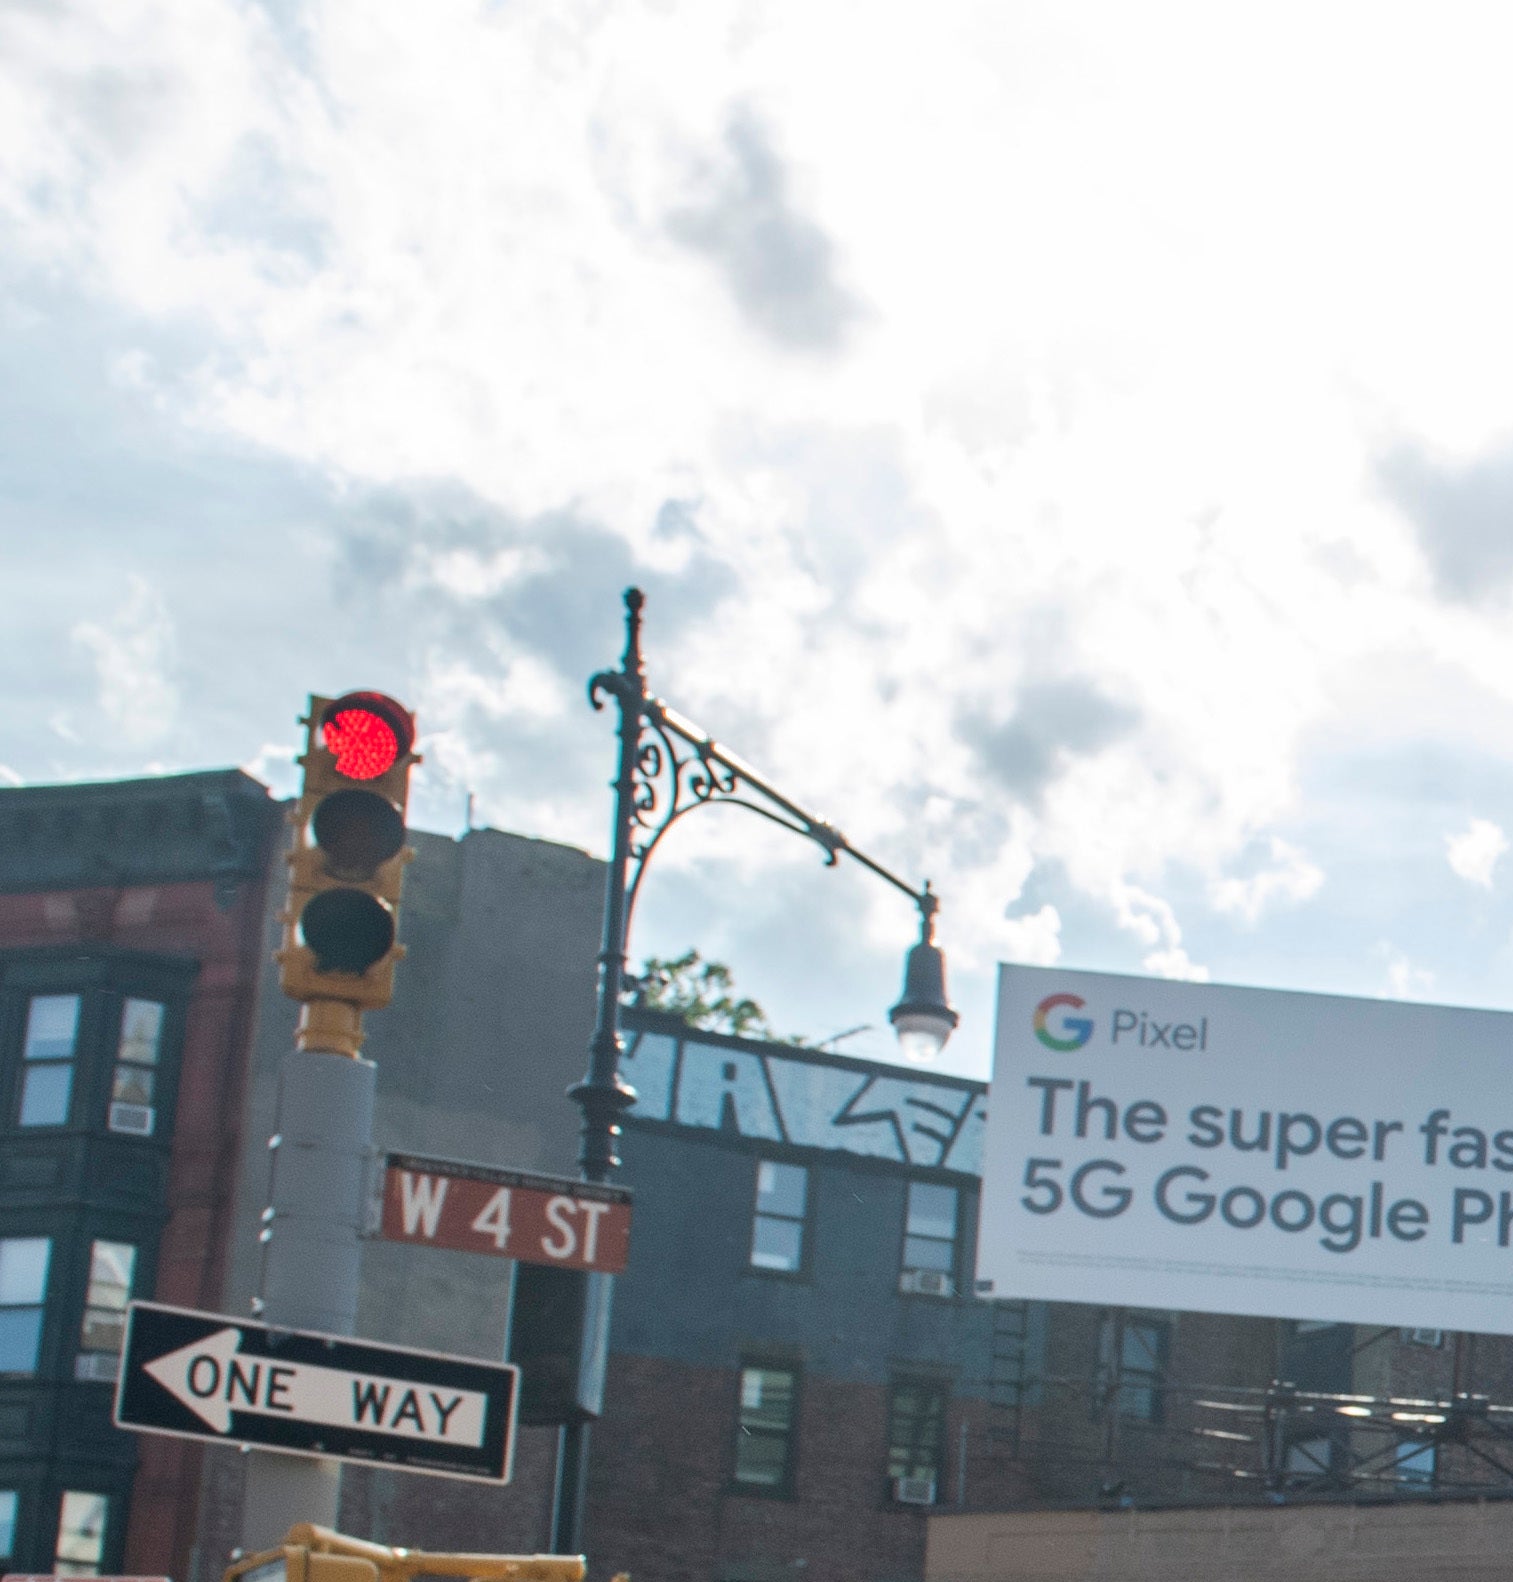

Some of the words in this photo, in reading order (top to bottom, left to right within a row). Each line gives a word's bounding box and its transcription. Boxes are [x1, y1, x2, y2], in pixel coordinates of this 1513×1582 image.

[1111, 1009, 1208, 1051] Pixel
[1027, 1076, 1168, 1144] The
[1187, 1101, 1403, 1170] super
[401, 1172, 449, 1239] W
[472, 1187, 511, 1250] 4
[542, 1195, 610, 1263] ST
[1020, 1157, 1134, 1219] 5G
[1153, 1165, 1430, 1254] Google
[186, 1354, 297, 1412] ONE
[351, 1379, 463, 1436] WAY
